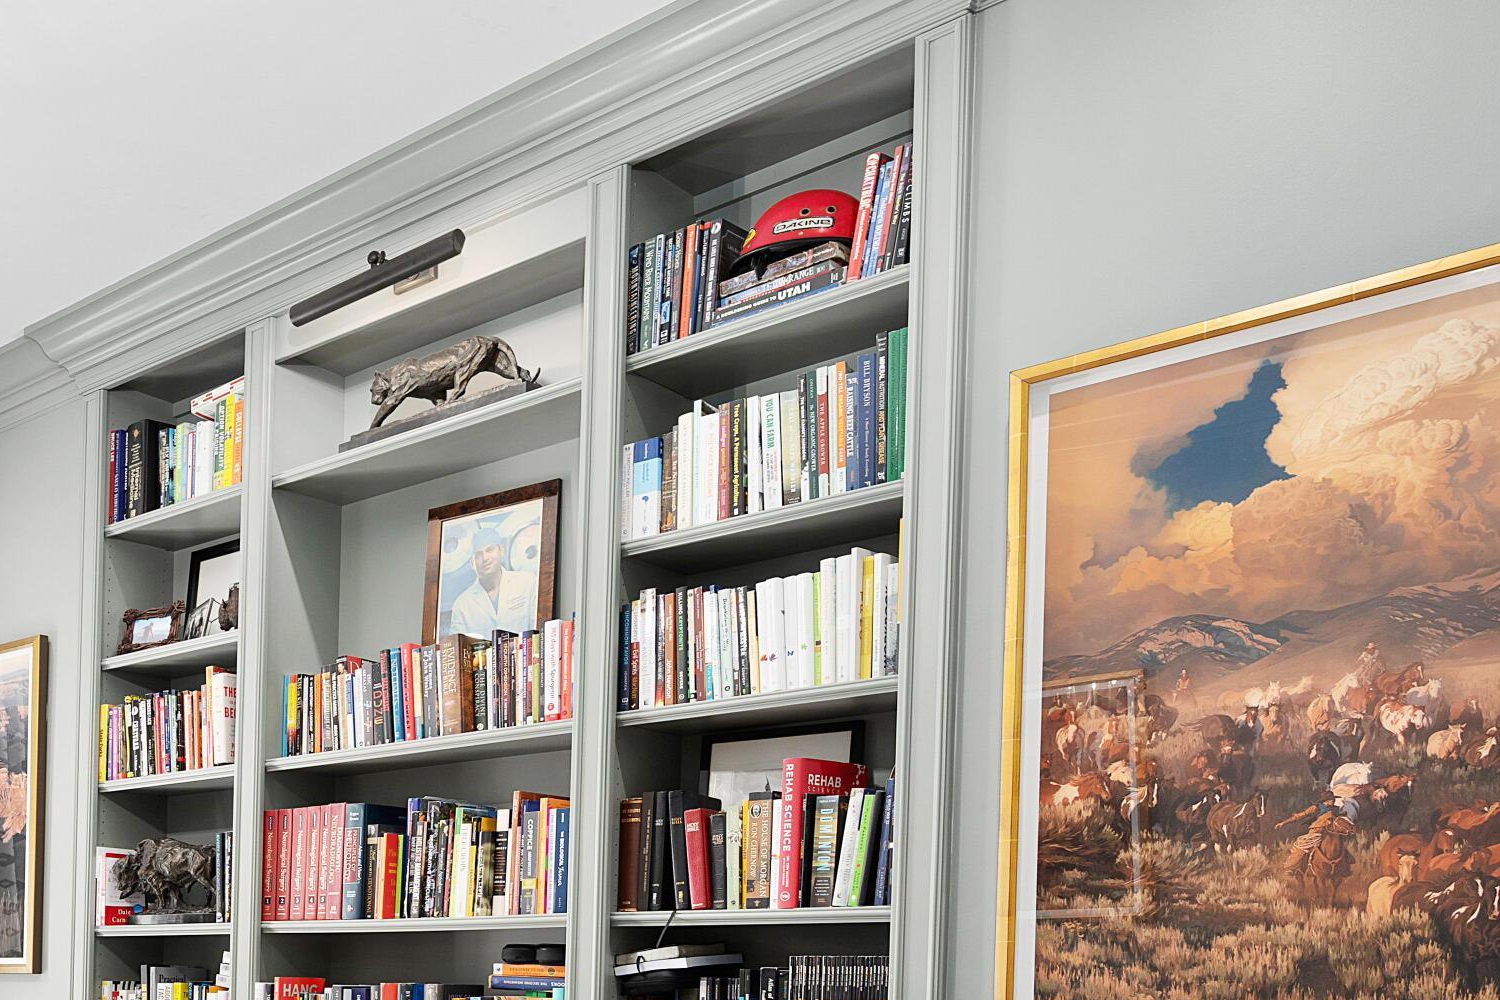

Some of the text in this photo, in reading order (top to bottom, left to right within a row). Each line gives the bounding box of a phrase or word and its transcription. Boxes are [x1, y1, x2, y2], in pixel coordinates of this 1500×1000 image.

[775, 219, 831, 231] DAKINE
[644, 269, 654, 286] RIVER
[777, 282, 810, 301] UTAH
[643, 287, 653, 321] MOUNTAINS
[846, 386, 854, 415] RAISING
[765, 398, 775, 449] YOU CAN FARM
[732, 475, 740, 506] Agriculture
[447, 647, 457, 694] EVIDENCE
[224, 686, 237, 697] THE
[808, 774, 842, 788] REHAB
[782, 763, 795, 852] REHAB SCIENCE
[761, 819, 769, 846] HOUSE
[816, 808, 833, 871] DOMINION
[294, 830, 304, 891] Neurological Surgery
[328, 815, 338, 884] NEURORADIOLOGY
[761, 848, 768, 858] OF
[265, 869, 273, 893] Surgery
[279, 869, 287, 892] Surgery
[308, 867, 316, 891] Surgery
[319, 867, 327, 891] Surgery
[412, 863, 421, 901] MANAGEMENT
[759, 860, 768, 897] MORGAN
